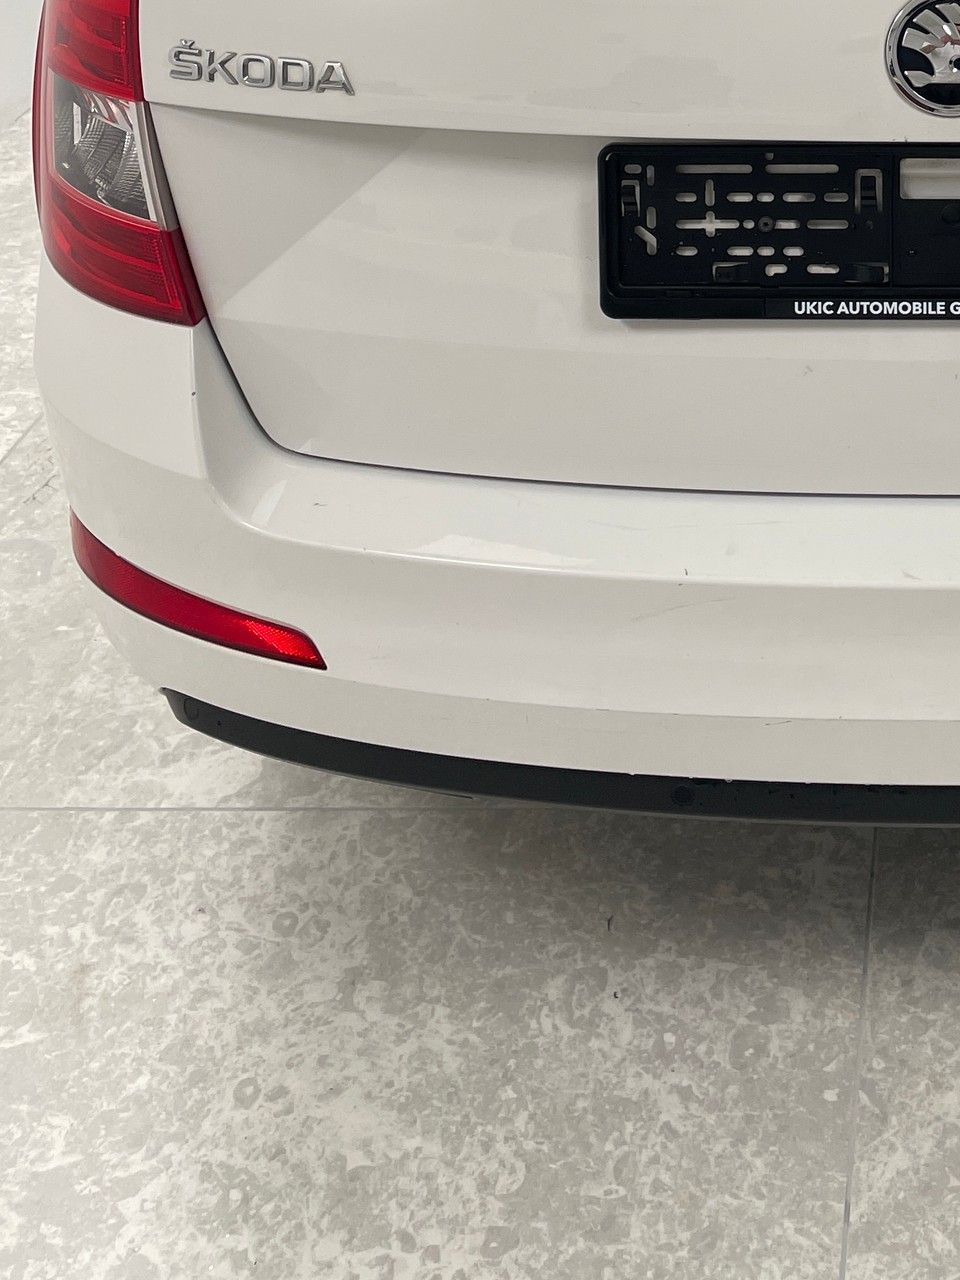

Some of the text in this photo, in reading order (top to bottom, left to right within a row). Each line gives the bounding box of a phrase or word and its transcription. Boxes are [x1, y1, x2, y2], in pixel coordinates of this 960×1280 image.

[168, 38, 355, 96] ŠKODA
[794, 301, 834, 315] UKIC
[837, 301, 946, 315] AUTOMOBILE
